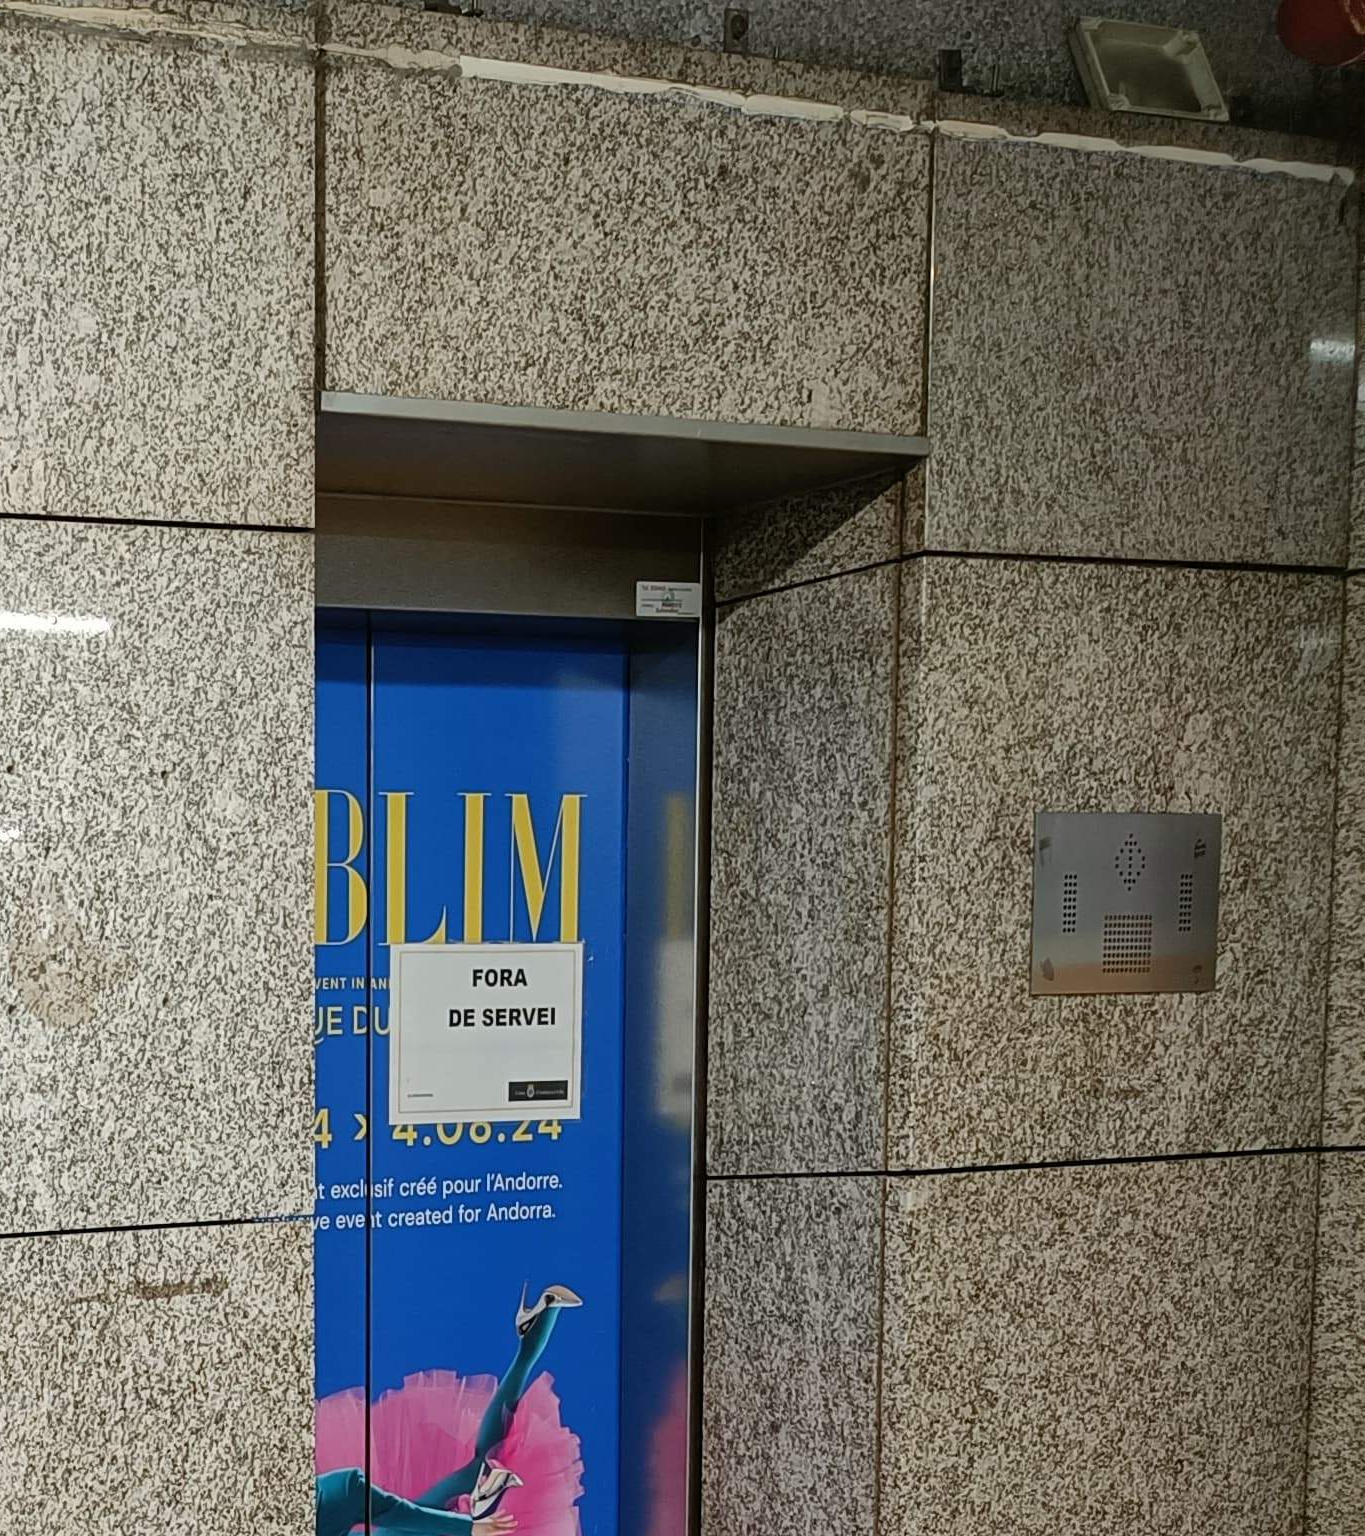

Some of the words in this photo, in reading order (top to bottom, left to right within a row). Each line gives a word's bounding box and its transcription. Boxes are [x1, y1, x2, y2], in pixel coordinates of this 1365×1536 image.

[351, 977, 365, 990] IN
[472, 968, 528, 988] FORA
[448, 1008, 475, 1027] DE
[482, 1007, 556, 1027] SERVEI
[399, 1176, 437, 1197] créé
[442, 1178, 481, 1199] pour
[388, 1205, 453, 1227] created
[458, 1204, 481, 1223] for
[486, 1201, 556, 1222] Andorra.
